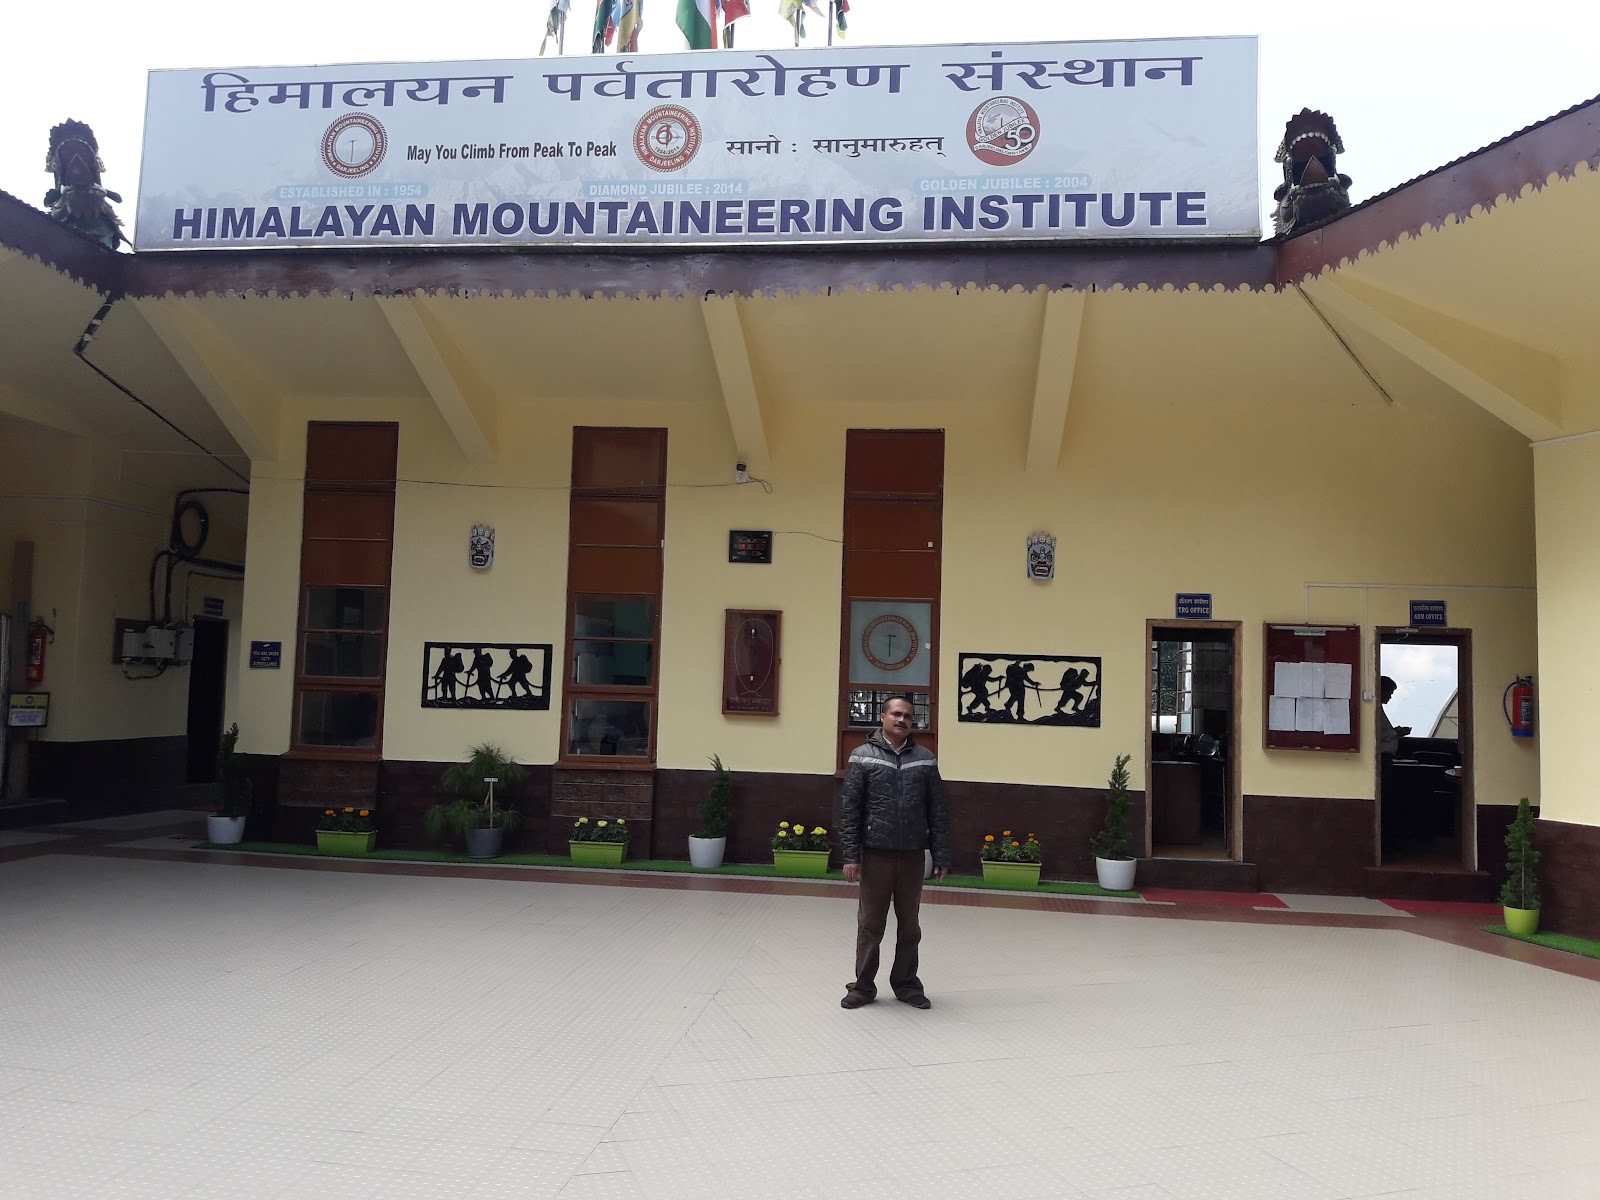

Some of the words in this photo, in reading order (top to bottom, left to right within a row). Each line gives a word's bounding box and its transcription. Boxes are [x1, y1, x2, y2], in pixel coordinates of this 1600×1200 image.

[201, 72, 514, 113] हिमालयन
[543, 55, 911, 101] पर्वतारोहण
[942, 51, 1203, 92] संस्थान
[726, 135, 781, 155] सानो
[813, 137, 947, 157] सानुमारुहत्
[1004, 123, 1036, 151] 50
[407, 145, 431, 164] May
[435, 145, 457, 160] You
[461, 143, 495, 159] Climb
[499, 143, 529, 158] From
[533, 142, 564, 158] Peak
[568, 141, 583, 157] To
[586, 141, 617, 157] Peak
[649, 155, 685, 167] DARJEELING
[279, 186, 364, 198] ESTABLISHED
[368, 186, 381, 197] IN
[392, 185, 422, 196] 1954
[589, 184, 647, 196] DIAMOND
[650, 183, 703, 195] JUBILEE
[713, 183, 743, 194] 2014
[920, 179, 977, 191] GOLDEN
[982, 177, 1042, 190] JUBILEE
[1054, 176, 1088, 188] 2004
[172, 203, 435, 240] HIMALAYAN
[452, 197, 904, 236] MOUNTAINEERING
[922, 191, 1208, 231] INSTITUTE
